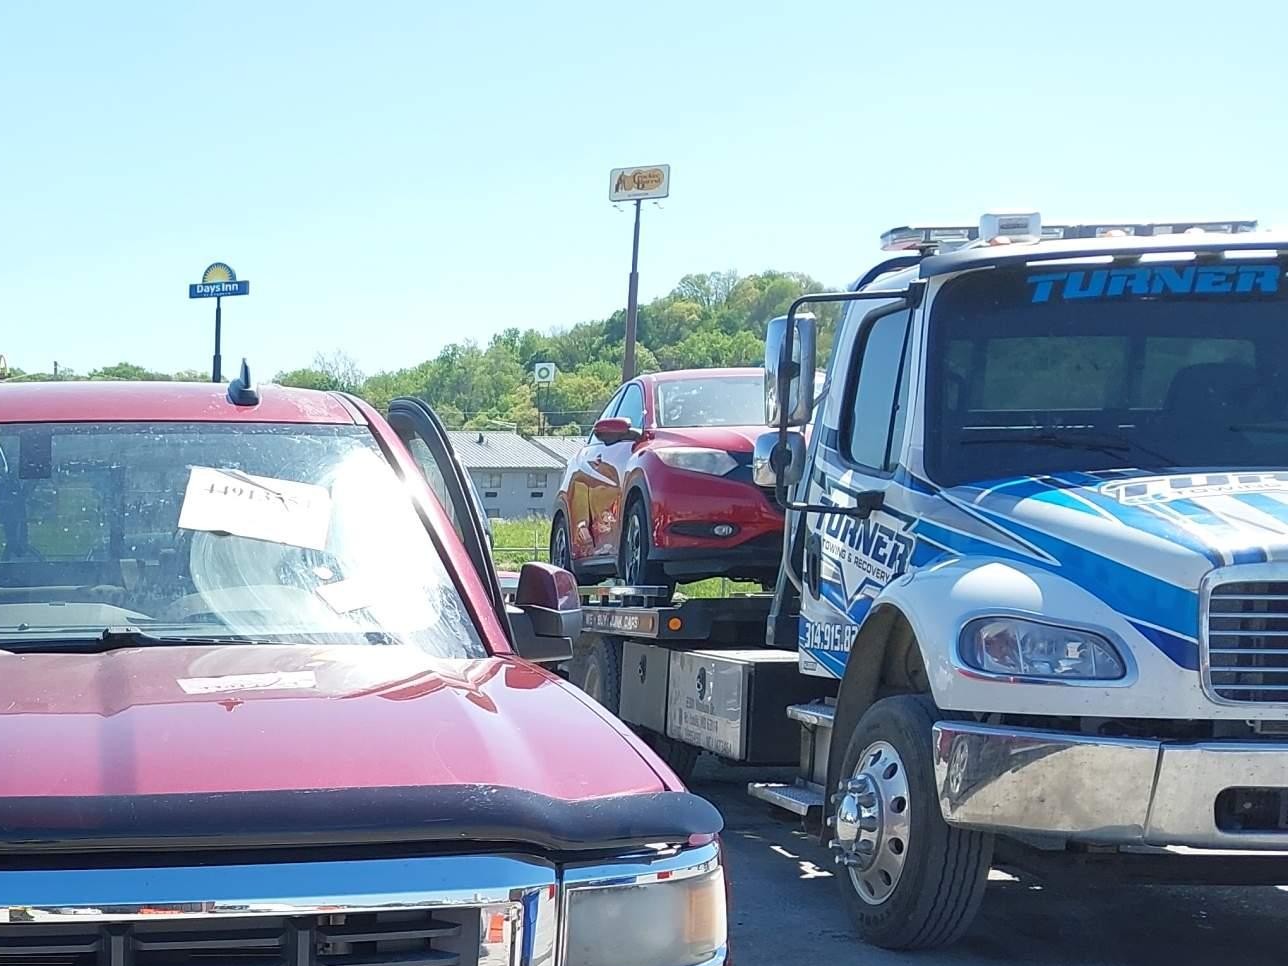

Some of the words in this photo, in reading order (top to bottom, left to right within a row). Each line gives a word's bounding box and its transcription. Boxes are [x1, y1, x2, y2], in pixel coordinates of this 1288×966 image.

[196, 284, 221, 294] Days
[222, 283, 239, 292] Inn
[1027, 264, 1280, 303] TURNER
[815, 495, 914, 575] TURNER
[853, 556, 890, 582] RECOVERY
